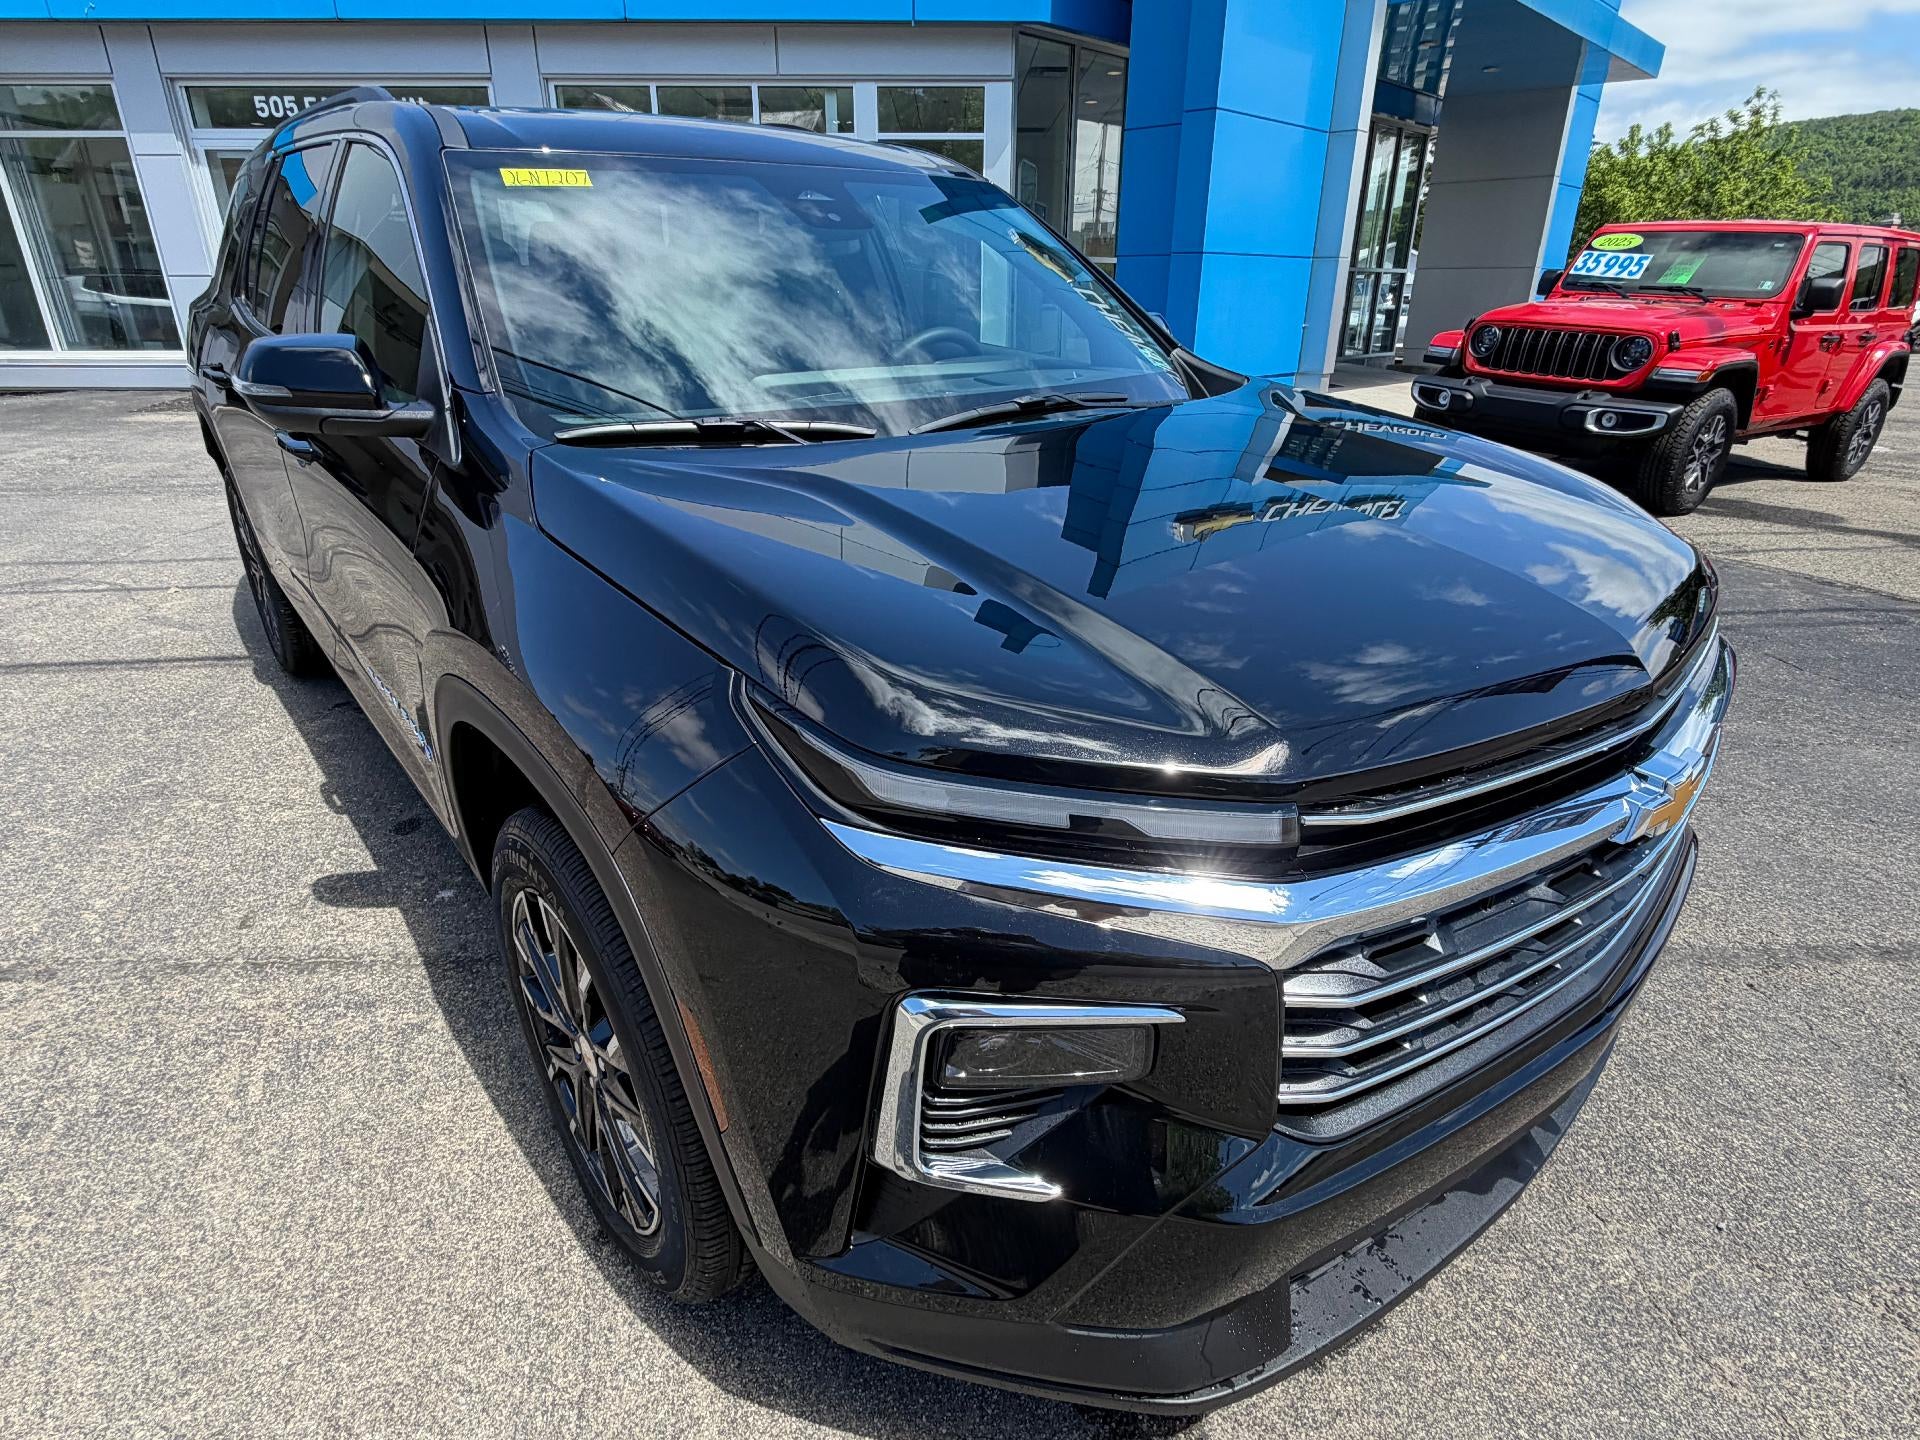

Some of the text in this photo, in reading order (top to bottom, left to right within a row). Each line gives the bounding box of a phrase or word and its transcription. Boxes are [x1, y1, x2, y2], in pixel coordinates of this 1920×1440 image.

[253, 95, 299, 118] 505
[1599, 237, 1635, 247] 2025
[1573, 252, 1650, 277] 35995
